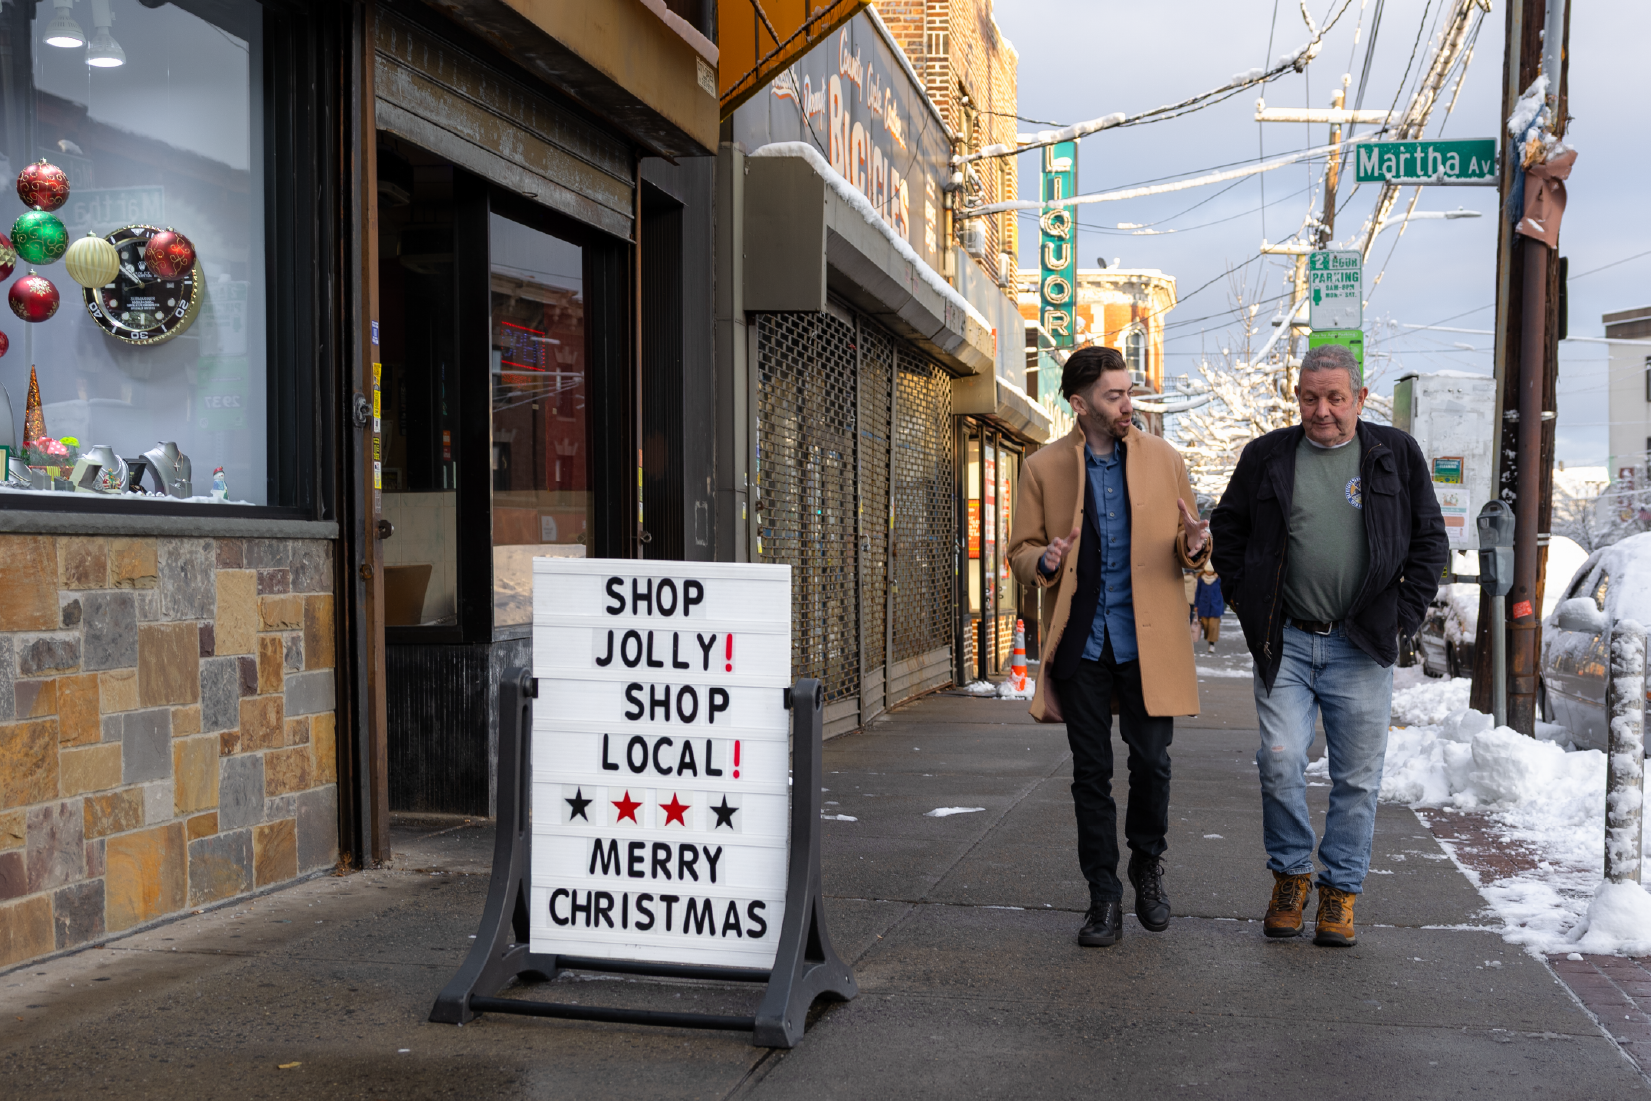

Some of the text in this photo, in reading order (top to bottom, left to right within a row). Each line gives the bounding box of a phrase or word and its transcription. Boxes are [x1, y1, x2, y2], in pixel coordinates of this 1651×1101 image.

[828, 74, 909, 243] BICYCLES
[1359, 146, 1491, 177] Martha Av
[1042, 145, 1071, 336] LIQUOR
[1312, 272, 1359, 283] PARKING
[1315, 255, 1324, 269] 2
[130, 331, 149, 340] 30
[606, 577, 703, 616] SHOP
[596, 630, 732, 672] JOLLY!
[625, 682, 729, 724] SHOP
[602, 734, 740, 778] LOCAL!
[590, 838, 722, 883] MERRY
[549, 888, 767, 938] CHRISTMAS
